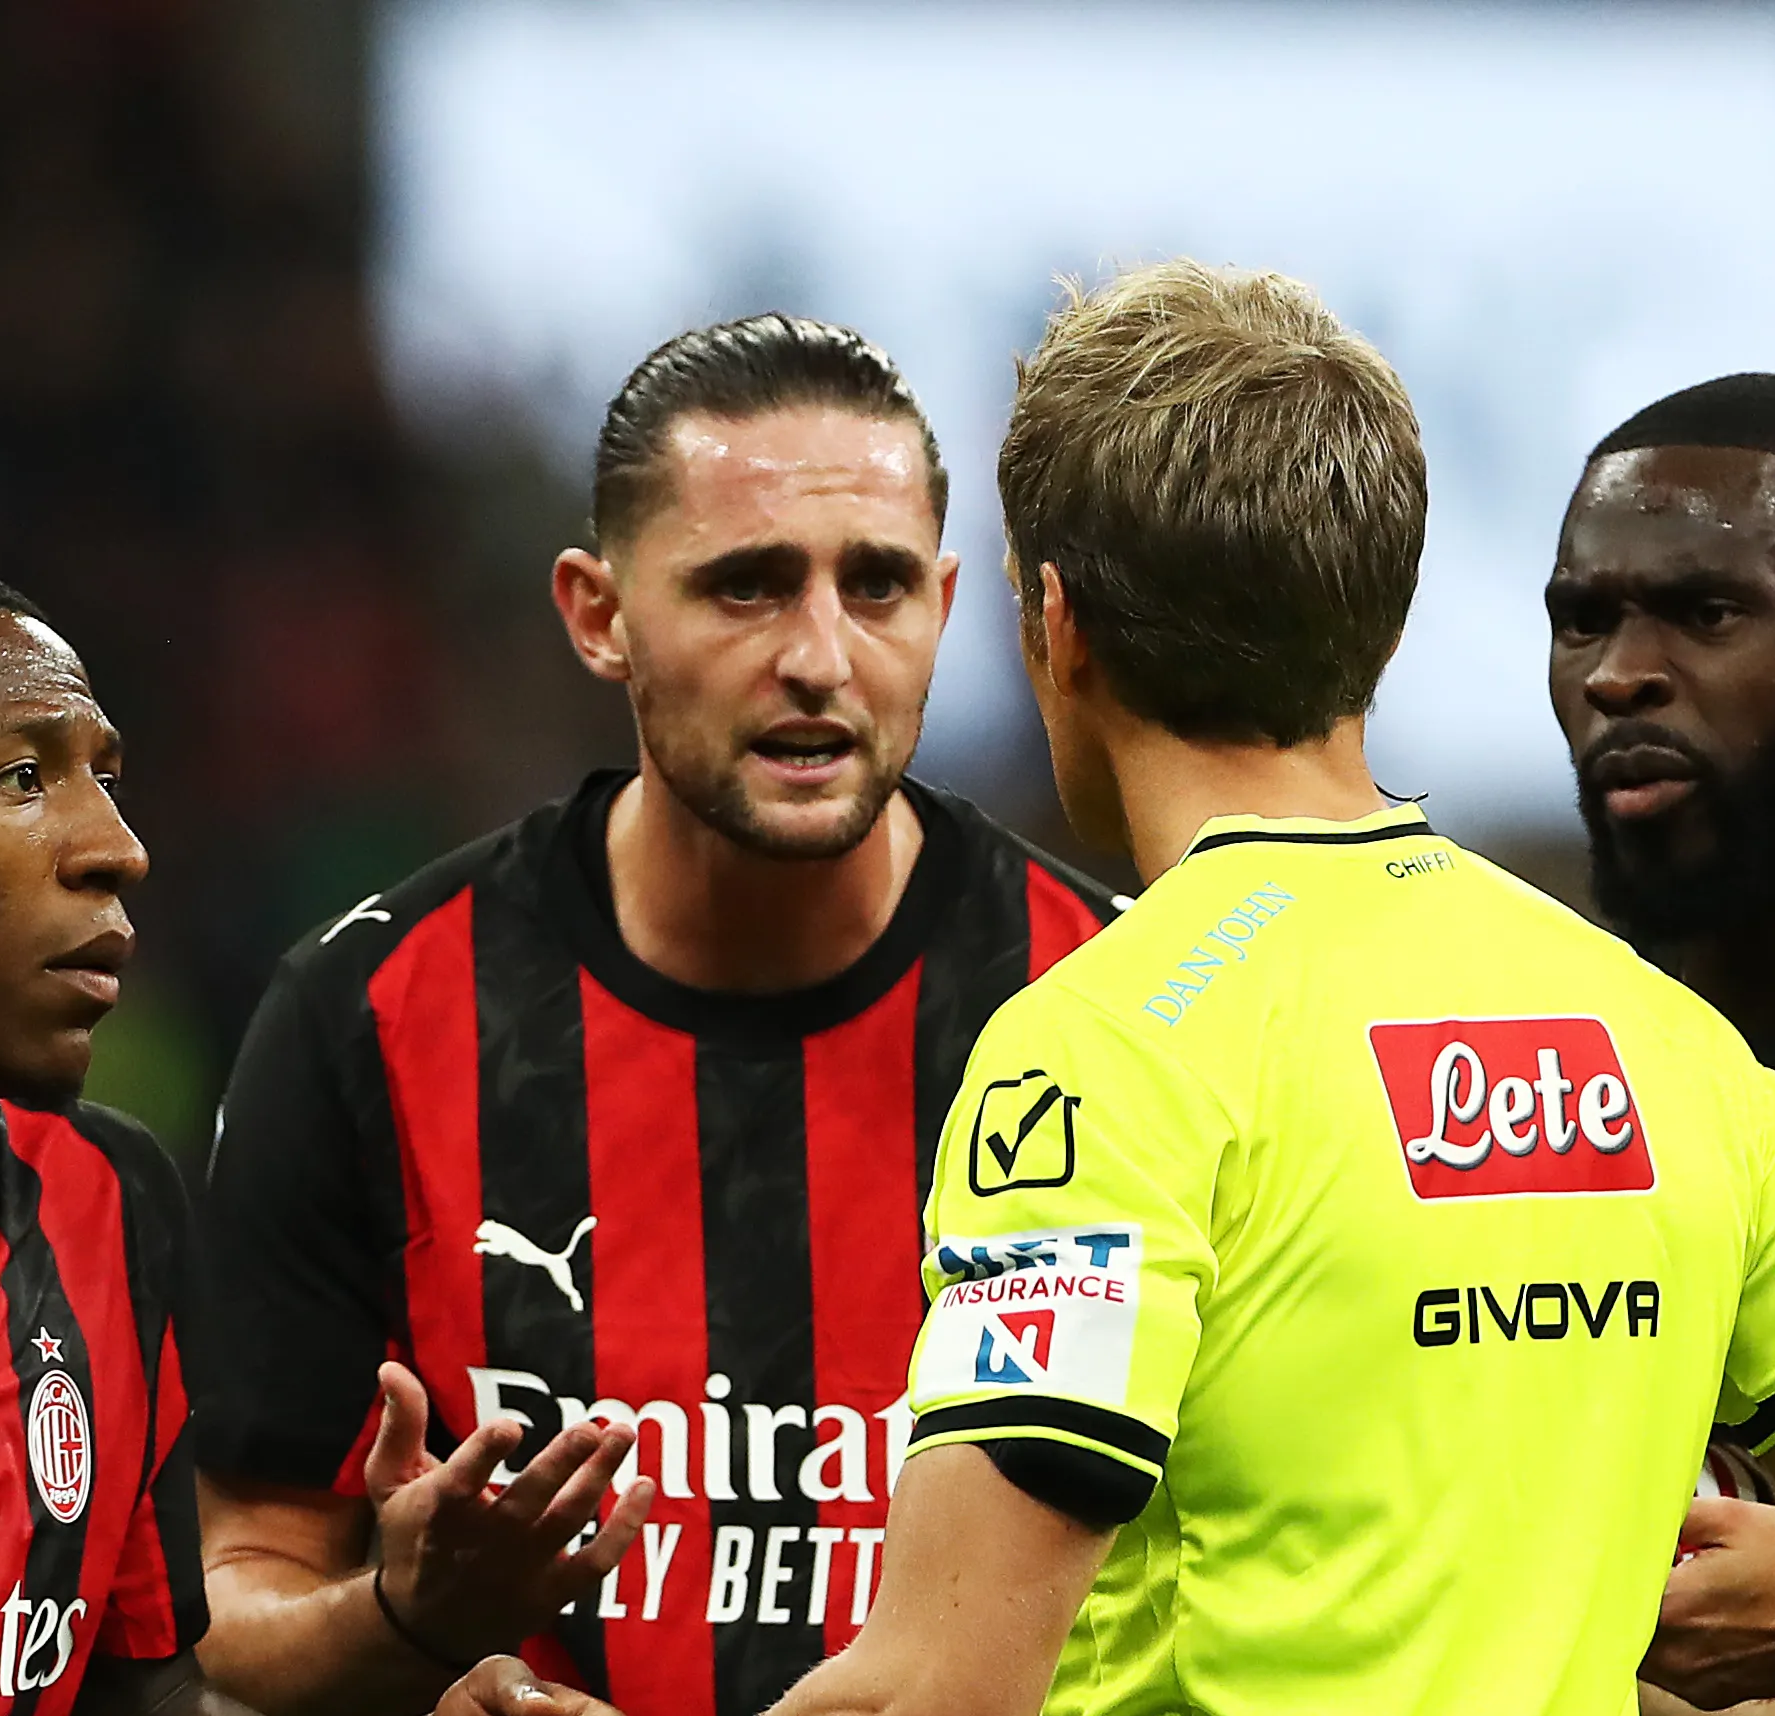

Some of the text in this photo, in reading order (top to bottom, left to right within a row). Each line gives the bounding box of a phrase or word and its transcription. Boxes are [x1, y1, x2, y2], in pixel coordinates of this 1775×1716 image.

[1142, 881, 1298, 1028] DAN JOHN
[1405, 1040, 1634, 1171] Lete
[943, 1275, 1125, 1309] INSURANCE
[1413, 1280, 1660, 1348] GIVOVA
[39, 1383, 74, 1413] ACM
[466, 1367, 916, 1502] Emirat
[48, 1487, 78, 1505] 1899
[706, 1525, 886, 1627] BETT
